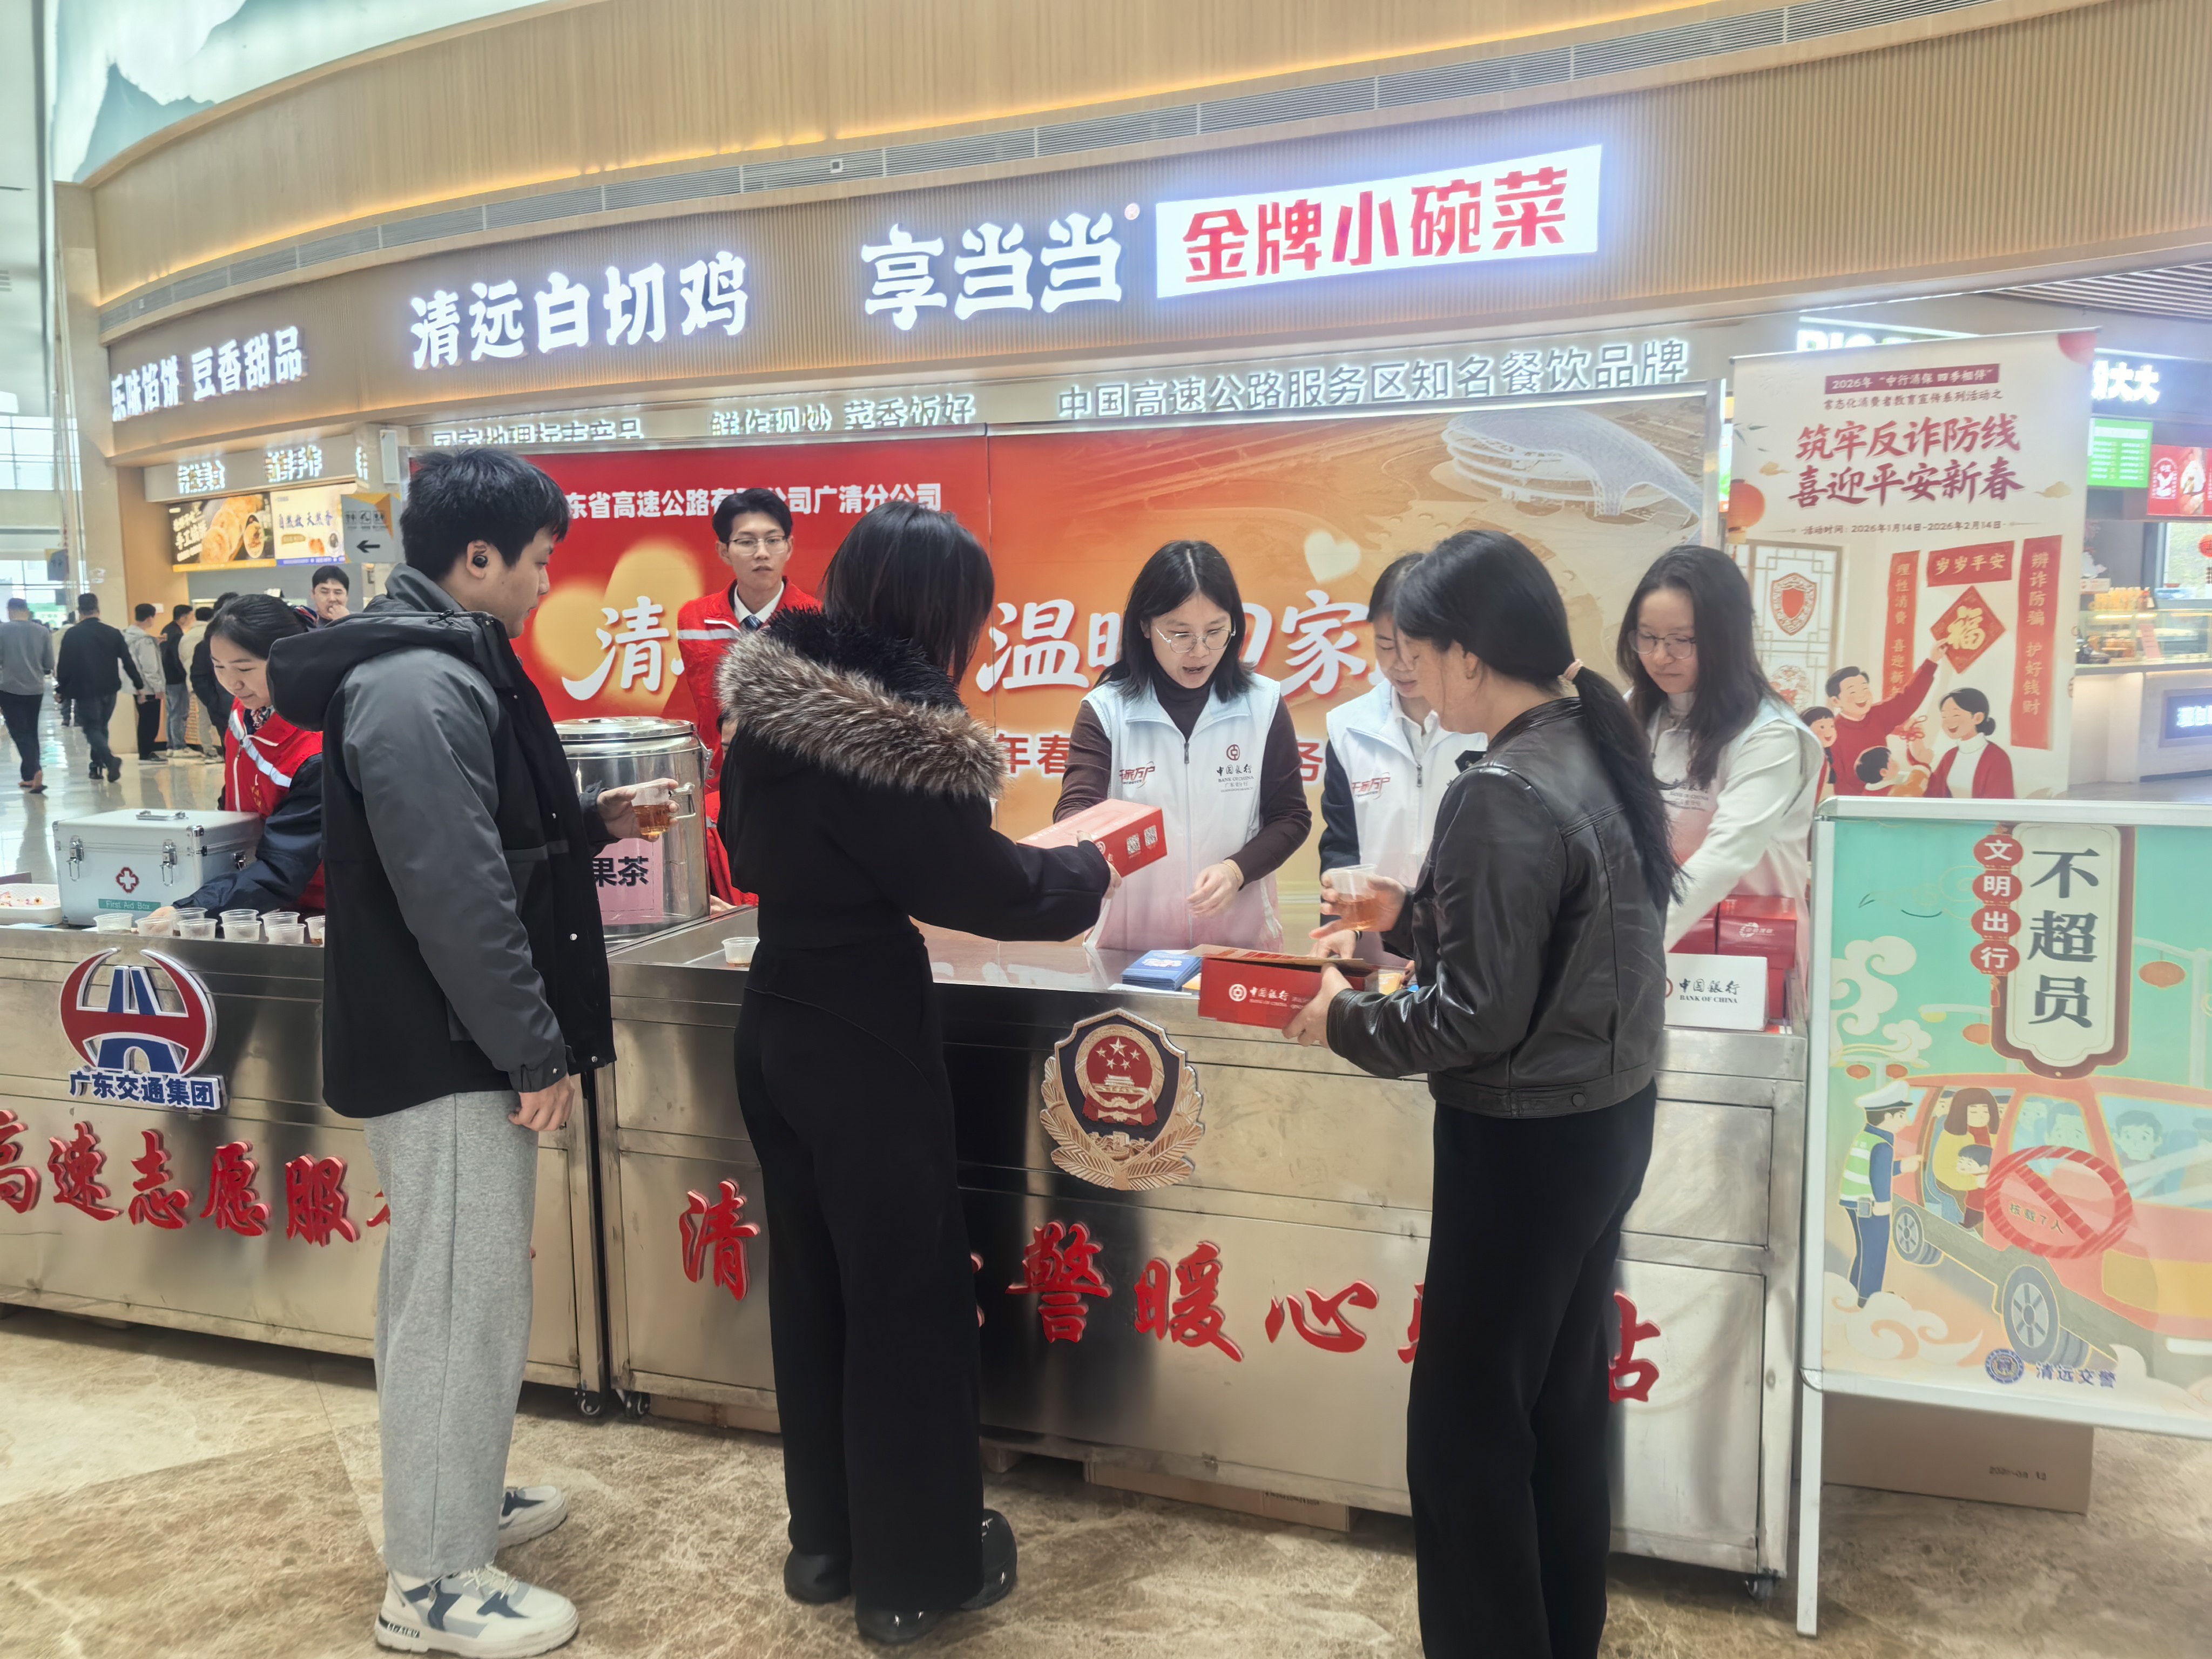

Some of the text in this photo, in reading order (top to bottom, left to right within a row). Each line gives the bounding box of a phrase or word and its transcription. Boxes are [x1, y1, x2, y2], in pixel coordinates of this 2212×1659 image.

[1182, 166, 1568, 284] 金牌小碗菜
[861, 211, 1122, 331] 享当当
[410, 250, 749, 369] 清远白切鸡
[191, 325, 302, 402] 豆香甜品
[1058, 340, 1689, 420] 中国高速公路服务区知名餐饮品牌
[1796, 413, 2021, 463] 筑牢反诈防线
[1788, 456, 2026, 509] 喜迎平安新春
[1934, 552, 2006, 576] 岁岁平安
[1894, 563, 1911, 625] 理性消费
[1946, 605, 1986, 650] 福
[2022, 641, 2044, 716] 护好钱财
[1216, 764, 1252, 777] 中国银行
[106, 900, 150, 910] First Aid Box
[1979, 839, 2101, 1029] 文明出行 不超员
[1678, 978, 1741, 995] 中国银行
[69, 1070, 218, 1109] 广东交通集团
[2035, 1360, 2116, 1388] 清远交警
